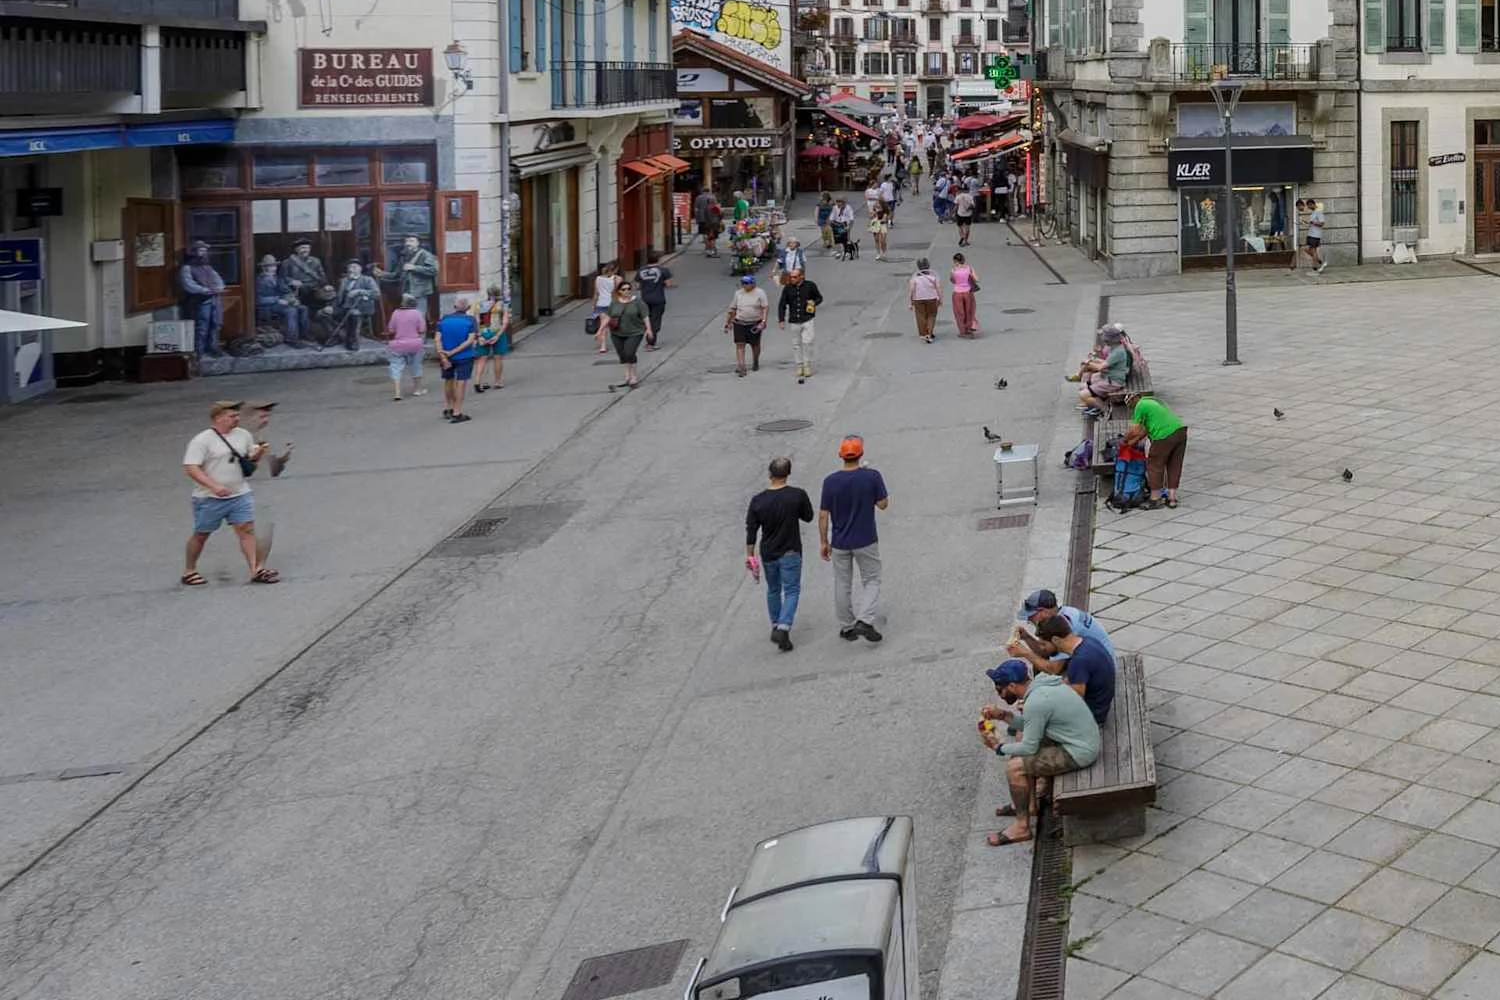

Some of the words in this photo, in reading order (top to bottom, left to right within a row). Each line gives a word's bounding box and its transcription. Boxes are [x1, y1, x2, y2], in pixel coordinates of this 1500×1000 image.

[312, 53, 419, 69] BUREAU
[311, 75, 325, 87] de
[327, 75, 338, 87] la
[355, 75, 374, 87] des
[375, 74, 423, 87] GUIDES
[315, 93, 419, 103] RENSEIGNEMENTS
[690, 136, 772, 149] OPTIQUE
